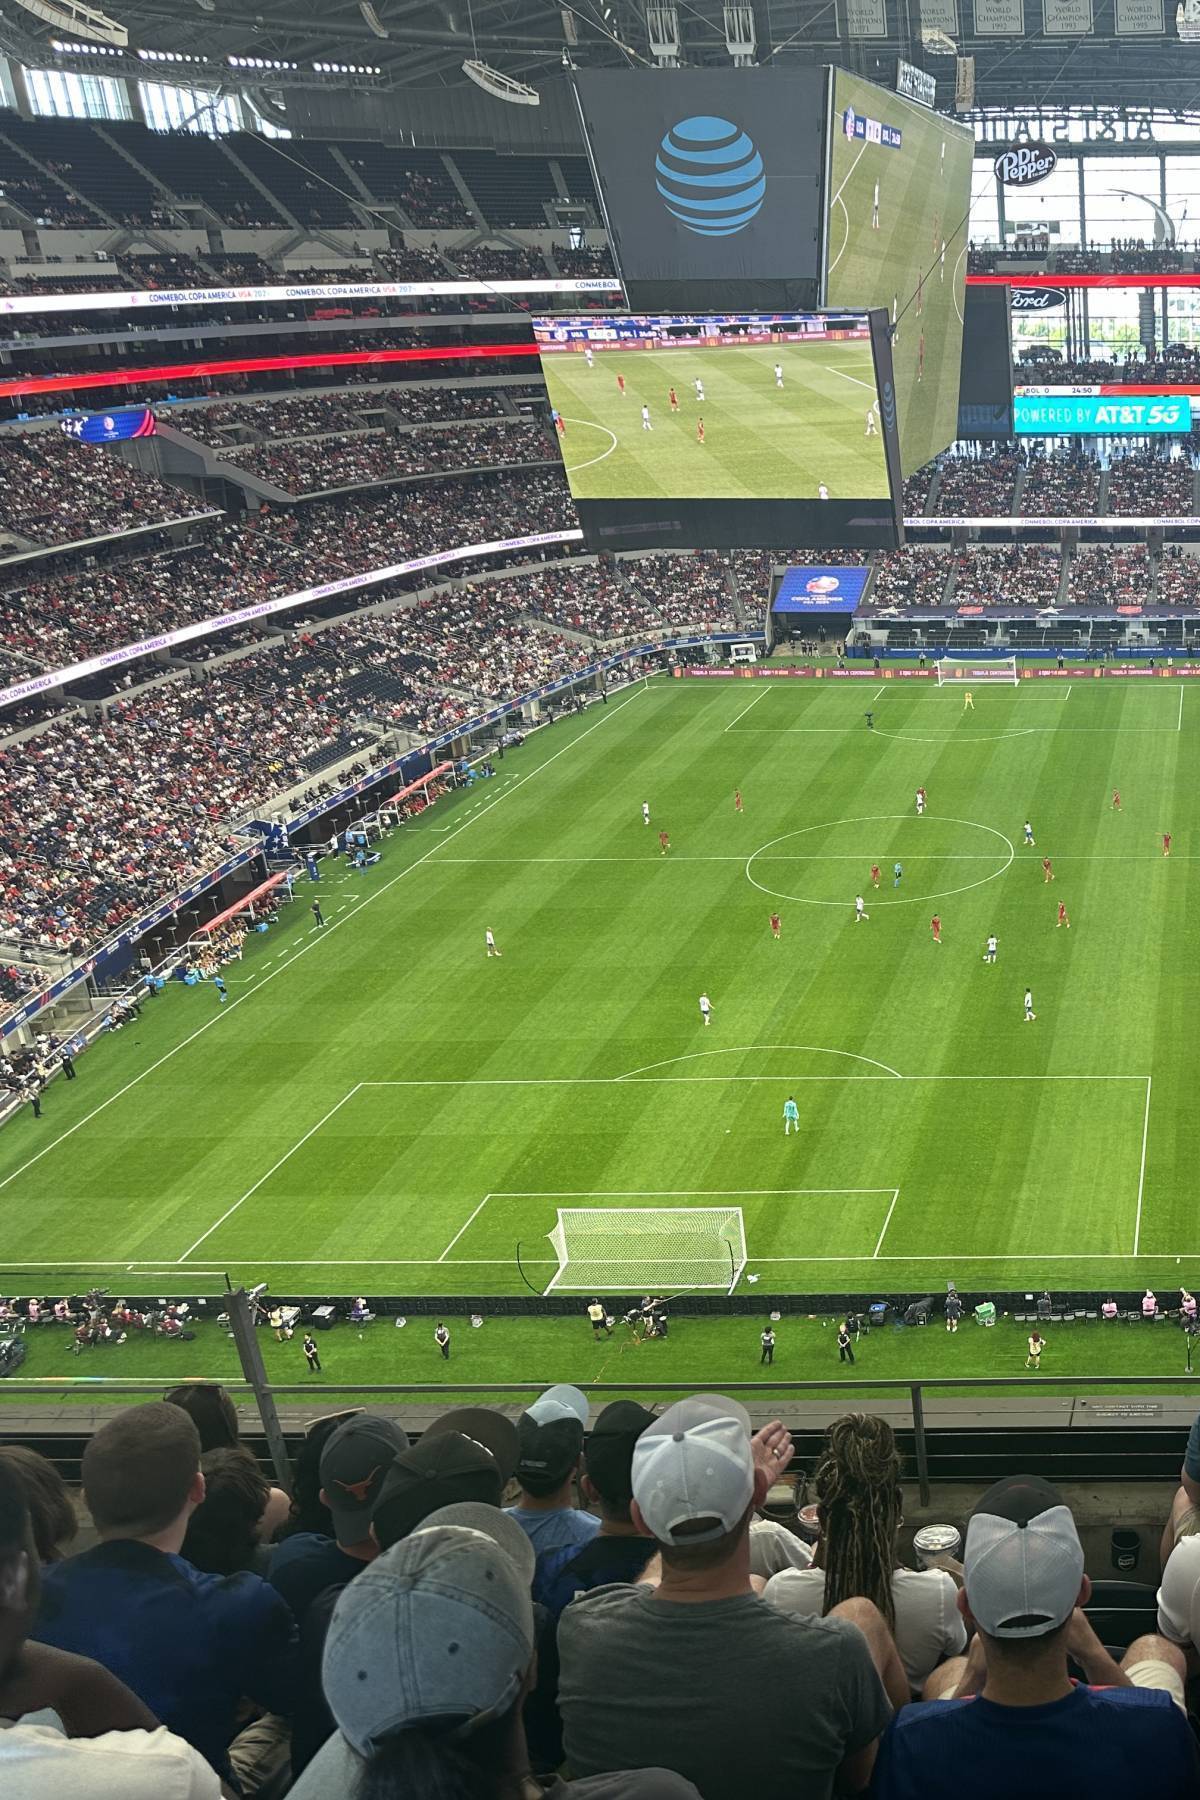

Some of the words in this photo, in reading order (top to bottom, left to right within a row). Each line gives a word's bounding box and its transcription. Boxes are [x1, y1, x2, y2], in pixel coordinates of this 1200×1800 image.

[1054, 5, 1081, 13] WORLD
[1125, 5, 1153, 13] WORLD
[978, 15, 1019, 23] CHAMPIONS
[1047, 14, 1089, 22] CHAMPIONS
[1118, 14, 1161, 22] CHAMPIONS
[992, 22, 1007, 30] 1992
[1018, 149, 1039, 165] Dr
[1003, 152, 1053, 181] Pepper
[574, 281, 617, 289] CONMEBOL
[1014, 406, 1072, 424] POWERED
[1078, 407, 1091, 424] BY
[1095, 405, 1149, 424] AT&T
[1146, 405, 1181, 425] 5G
[26, 678, 52, 692] AMERICA
